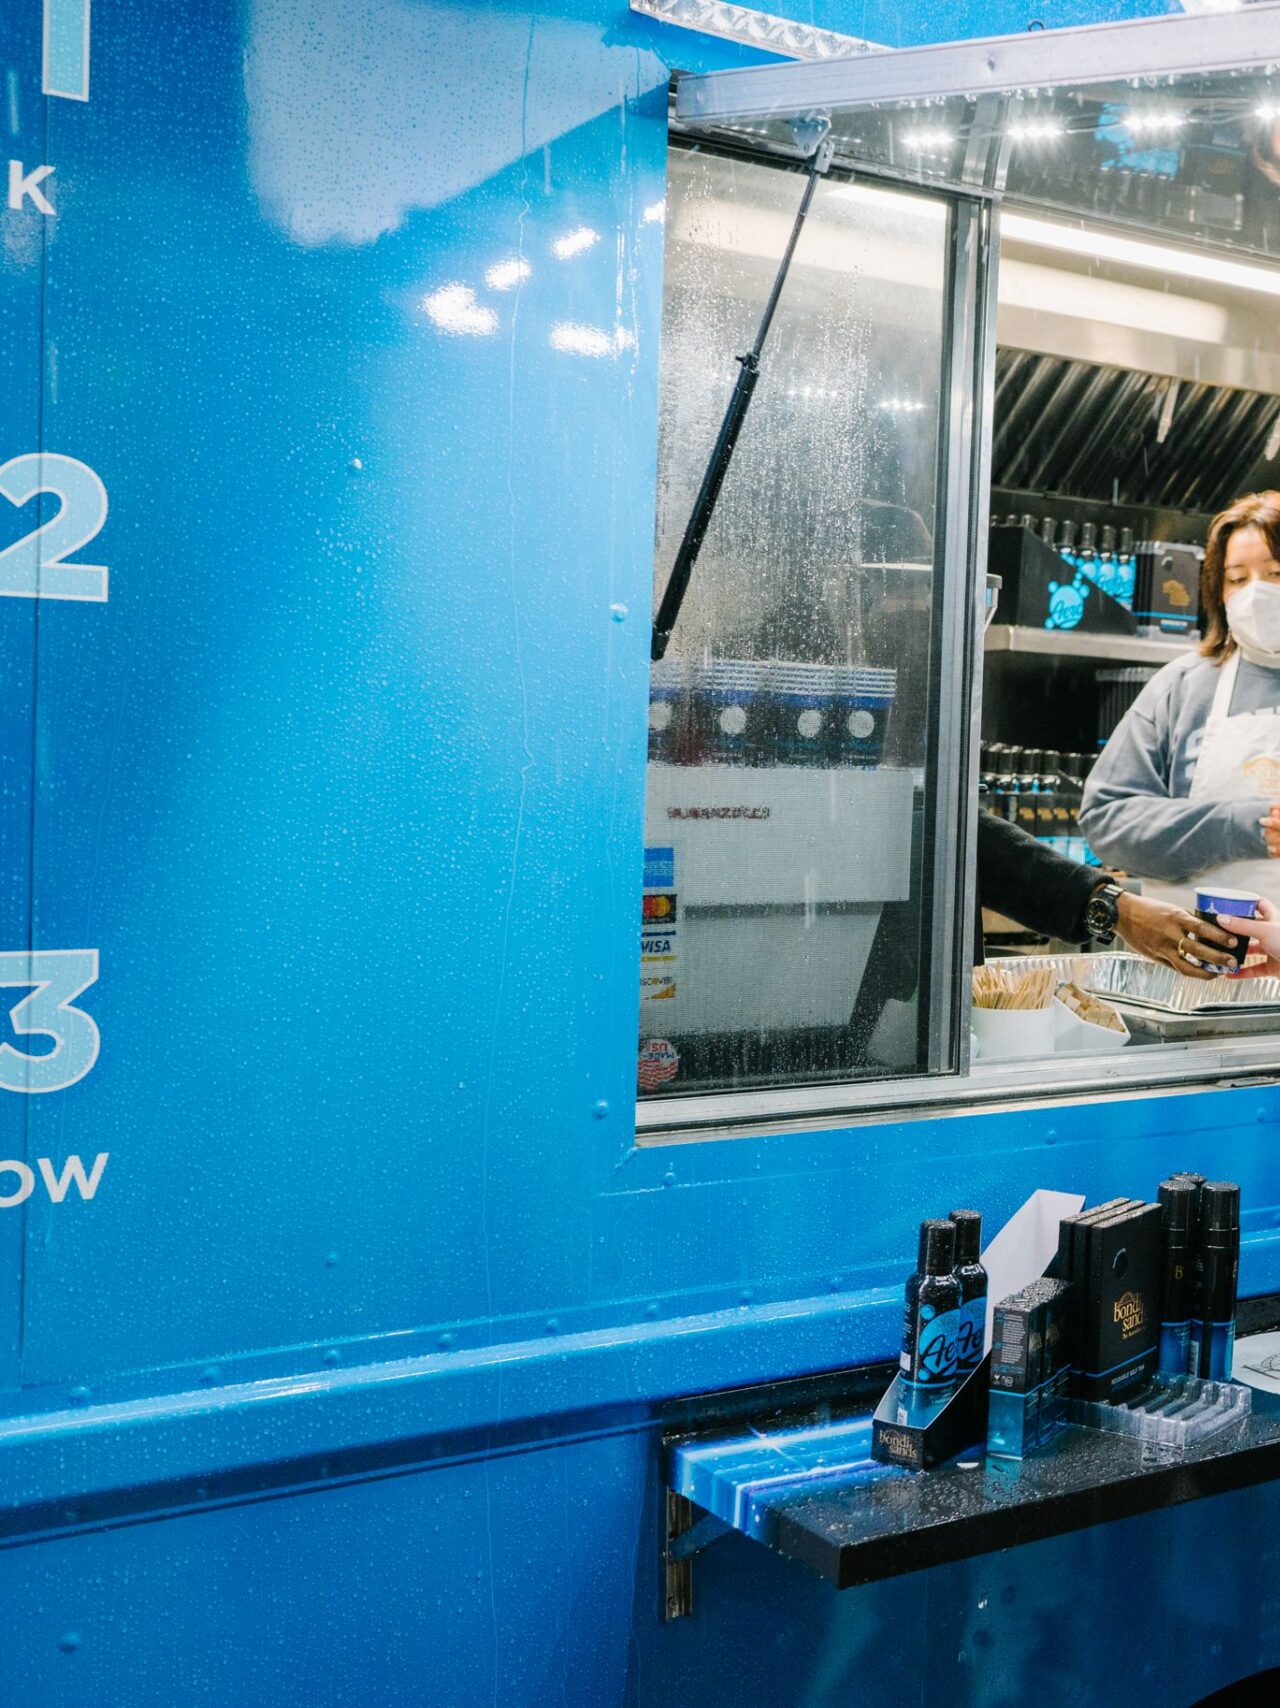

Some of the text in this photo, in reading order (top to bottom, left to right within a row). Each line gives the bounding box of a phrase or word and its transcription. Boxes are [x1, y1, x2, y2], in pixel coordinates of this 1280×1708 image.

[8, 159, 57, 215] K
[0, 453, 109, 602] 2
[641, 940, 671, 953] VISA
[0, 949, 100, 1093] 3
